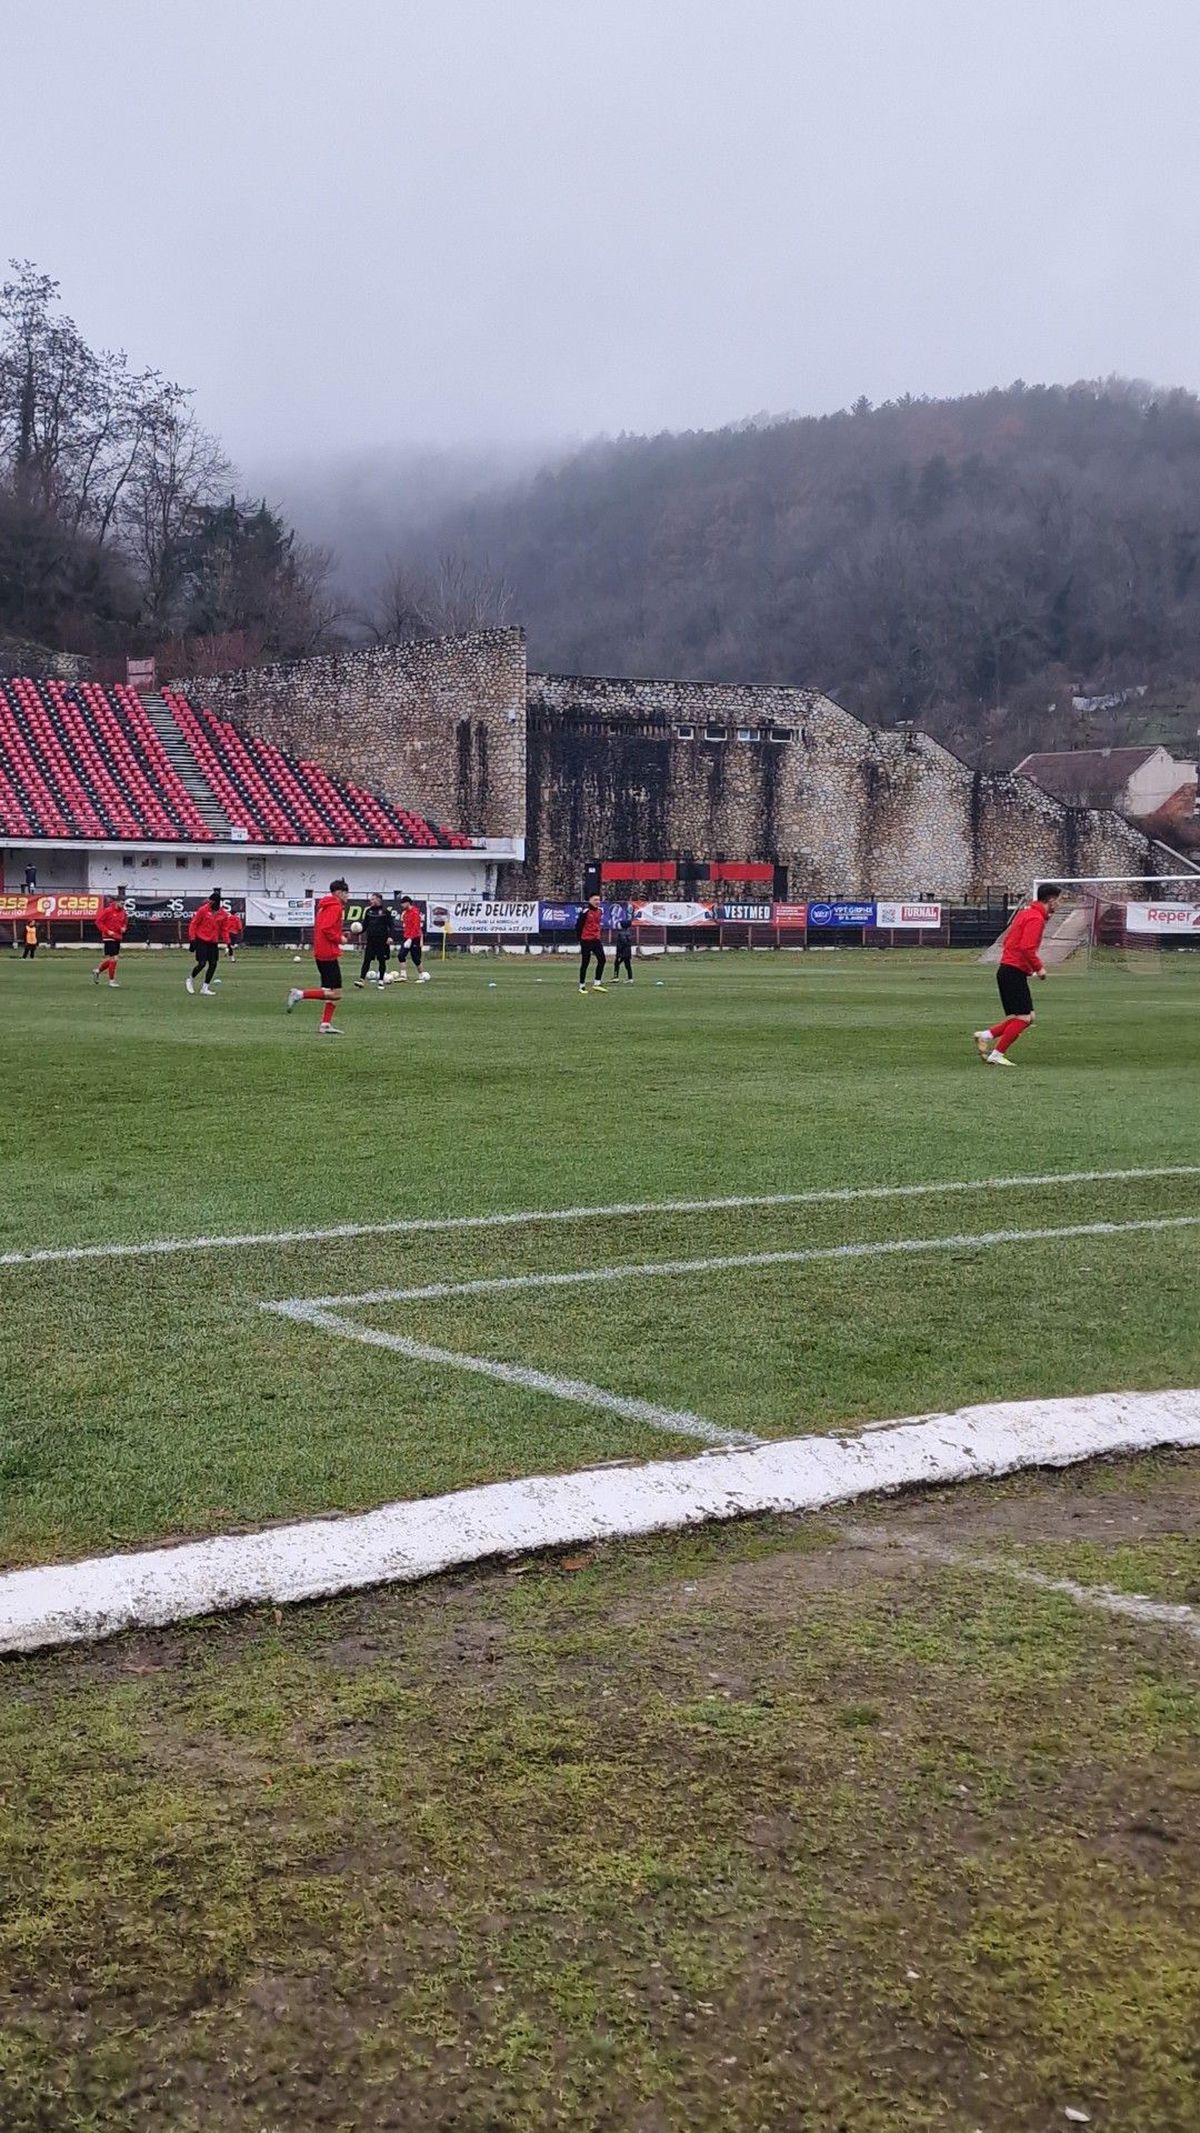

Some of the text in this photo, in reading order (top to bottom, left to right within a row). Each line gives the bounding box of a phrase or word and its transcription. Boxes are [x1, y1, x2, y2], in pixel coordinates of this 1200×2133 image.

[454, 903, 536, 917] CHEF DELIVERY
[724, 905, 770, 919] VESTMED
